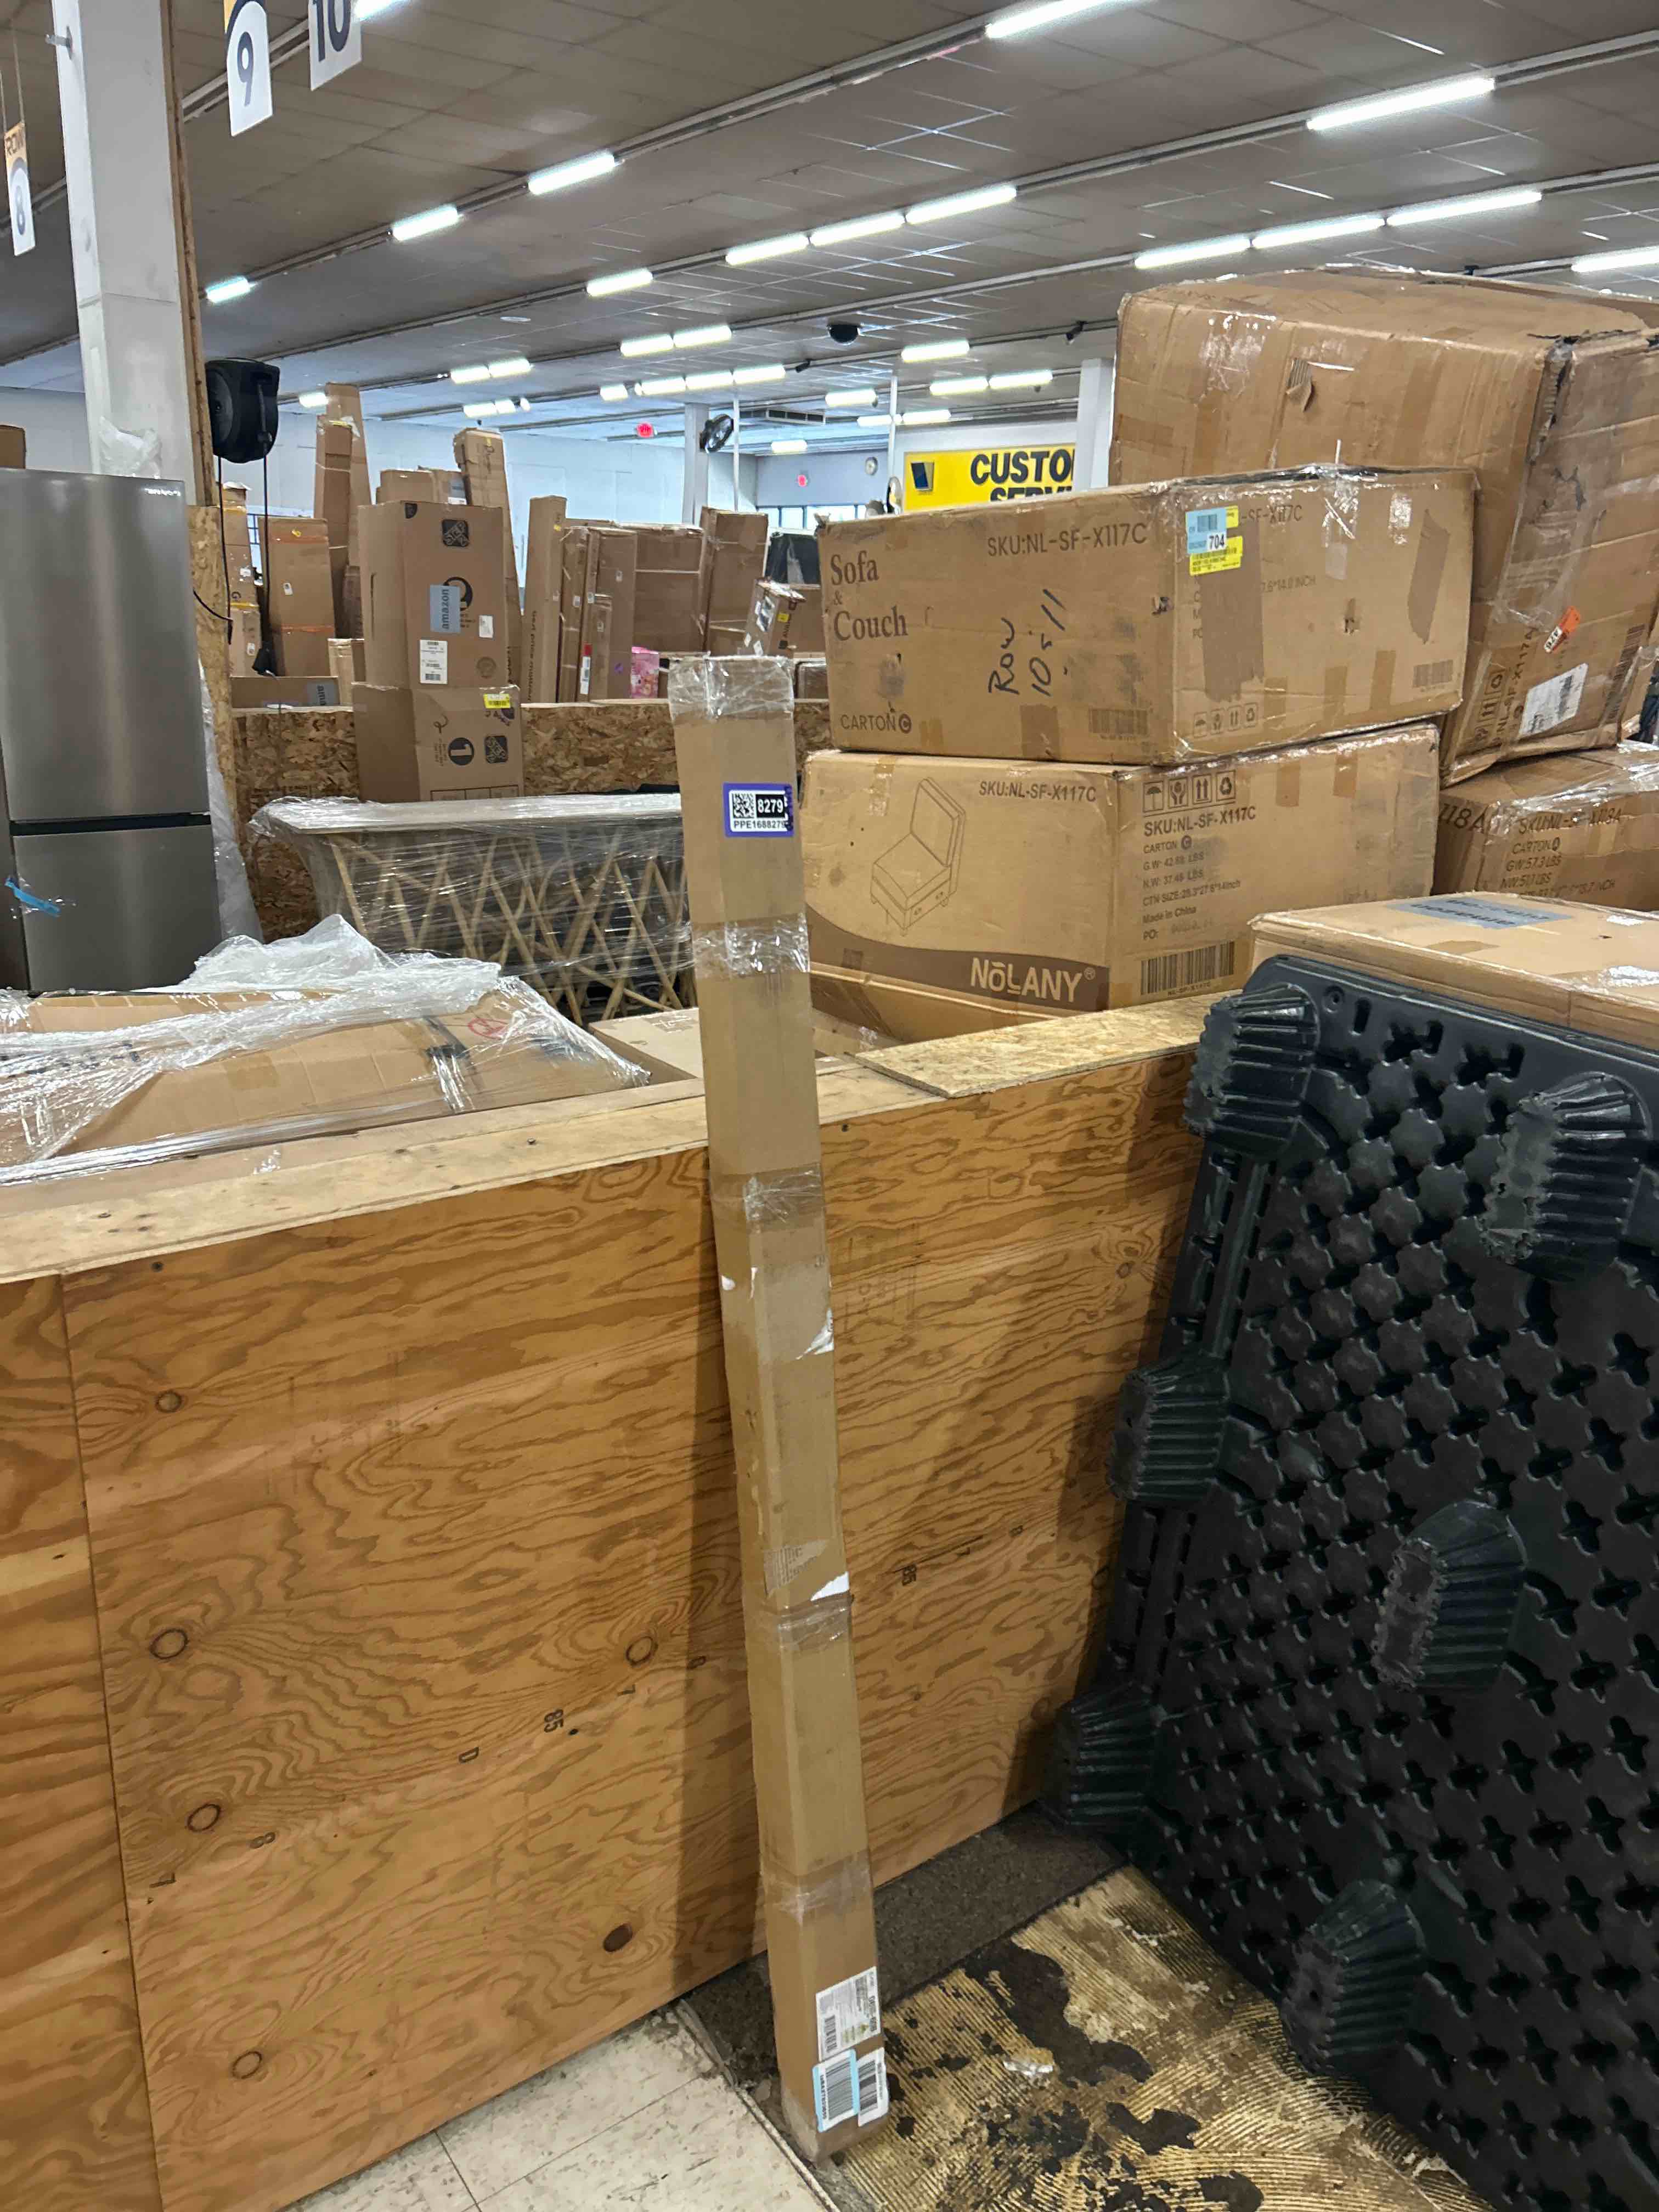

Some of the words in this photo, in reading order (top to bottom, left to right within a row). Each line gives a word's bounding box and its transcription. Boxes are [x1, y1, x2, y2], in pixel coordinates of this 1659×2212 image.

[313, 0, 351, 62] 10
[237, 32, 254, 106] 9
[15, 185, 26, 235] 8
[970, 448, 1075, 486] CUSTO
[987, 522, 1148, 557] SKU:NL-SF-X117C
[1209, 534, 1225, 549] 704
[831, 550, 879, 586] Sofa
[833, 590, 843, 606] &
[834, 604, 909, 641] Couch
[840, 713, 896, 731] CARTON
[757, 799, 784, 814] 8279
[979, 780, 1097, 803] SKU:NL-SF-X117C
[1144, 805, 1256, 837] SKU:NL-SF-X117C
[1143, 840, 1177, 854] CARTON
